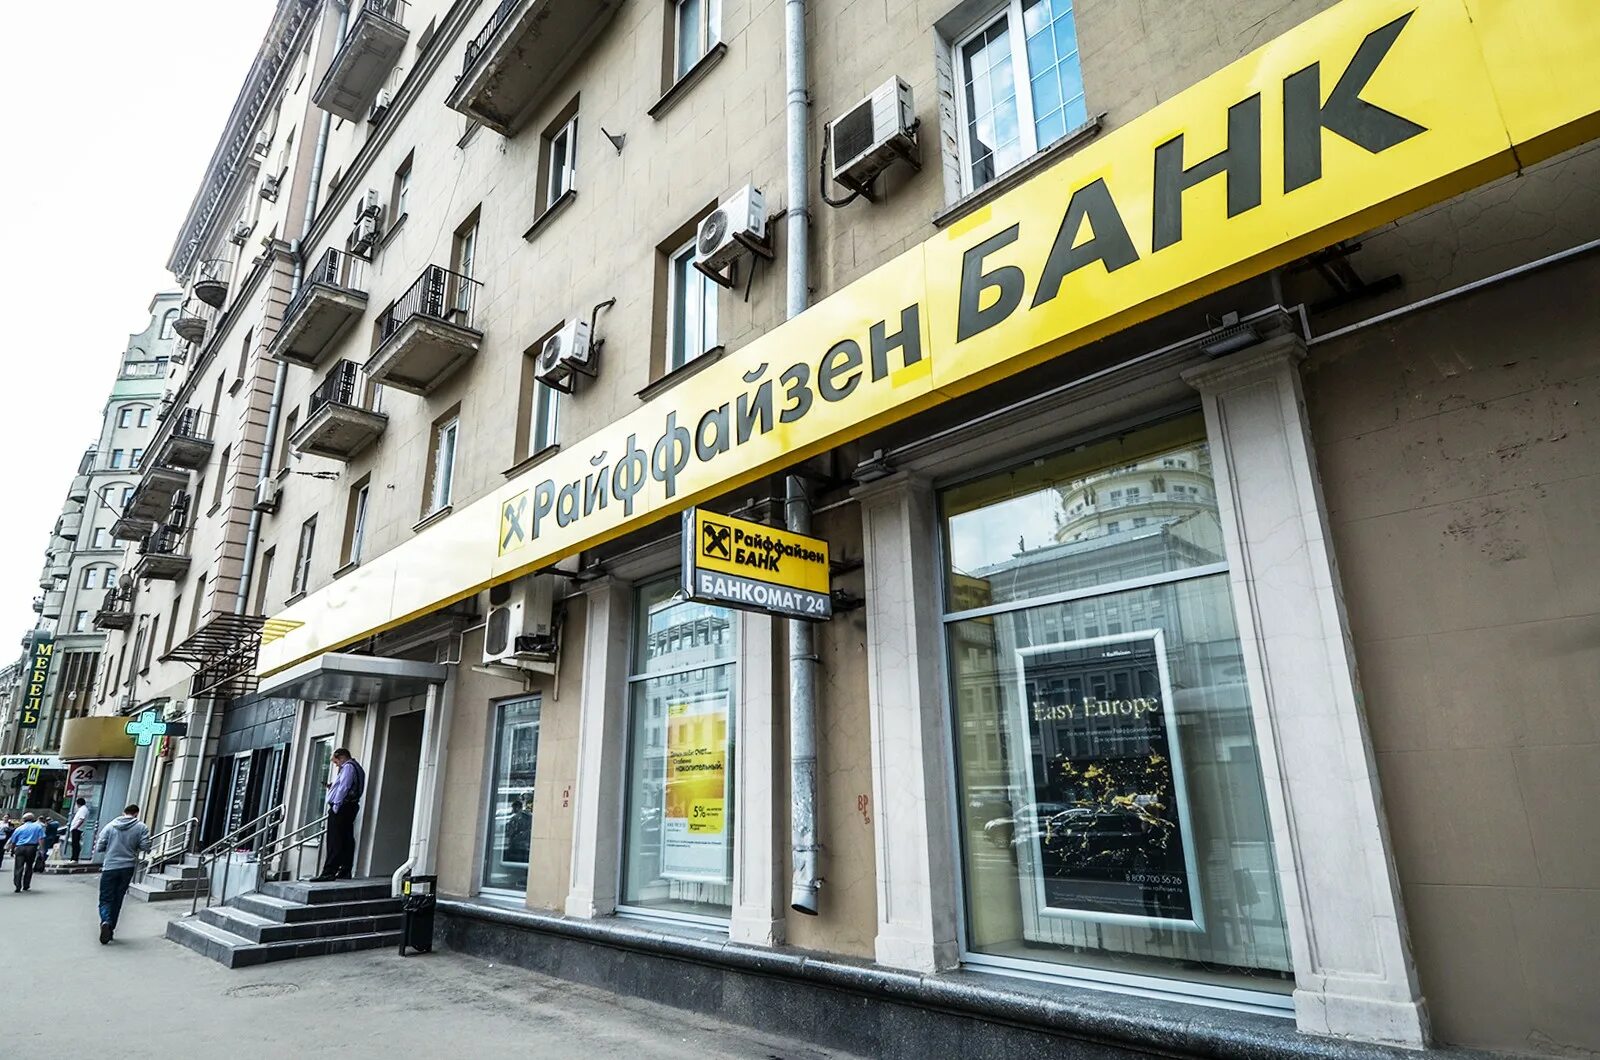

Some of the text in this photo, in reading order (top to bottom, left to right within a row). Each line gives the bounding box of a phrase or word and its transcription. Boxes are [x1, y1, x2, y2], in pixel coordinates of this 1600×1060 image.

[531, 7, 1429, 540] Райффайзен БАНК
[734, 528, 825, 564] Райффайзен
[735, 549, 779, 572] БАНК
[701, 574, 825, 613] БАНКОМАТ 24
[23, 643, 53, 724] МЕБЕЛЬ
[1032, 696, 1159, 722] Easy Europe
[7, 757, 50, 766] СБЕРБАНК
[76, 769, 94, 780] 24
[693, 805, 706, 818] 5%
[1126, 874, 1131, 882] 8
[1132, 874, 1145, 882] 800
[1147, 874, 1160, 883] 700
[1173, 876, 1183, 885] 26
